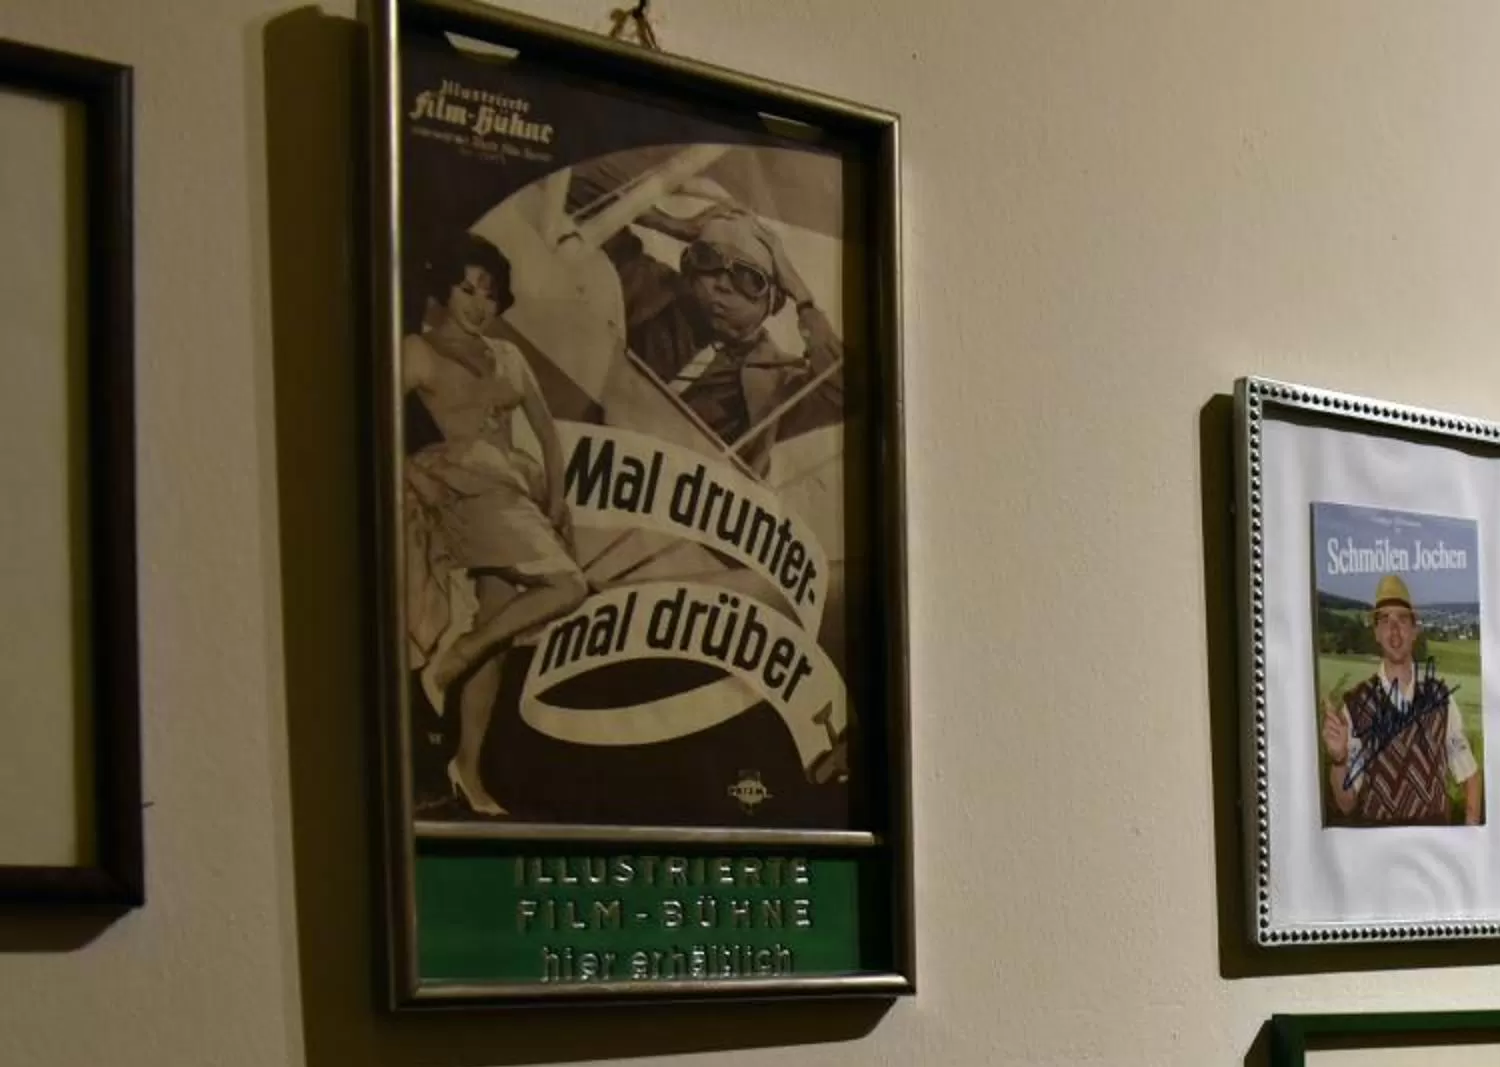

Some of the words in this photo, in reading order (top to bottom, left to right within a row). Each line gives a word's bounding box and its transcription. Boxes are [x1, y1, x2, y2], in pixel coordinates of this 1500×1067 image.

[564, 435, 664, 513] Mal
[1412, 540, 1468, 573] Jochen
[539, 591, 638, 676] mal
[646, 587, 813, 703] drüber
[513, 855, 811, 887] ILLUSTRIERTE
[540, 945, 616, 983] hier
